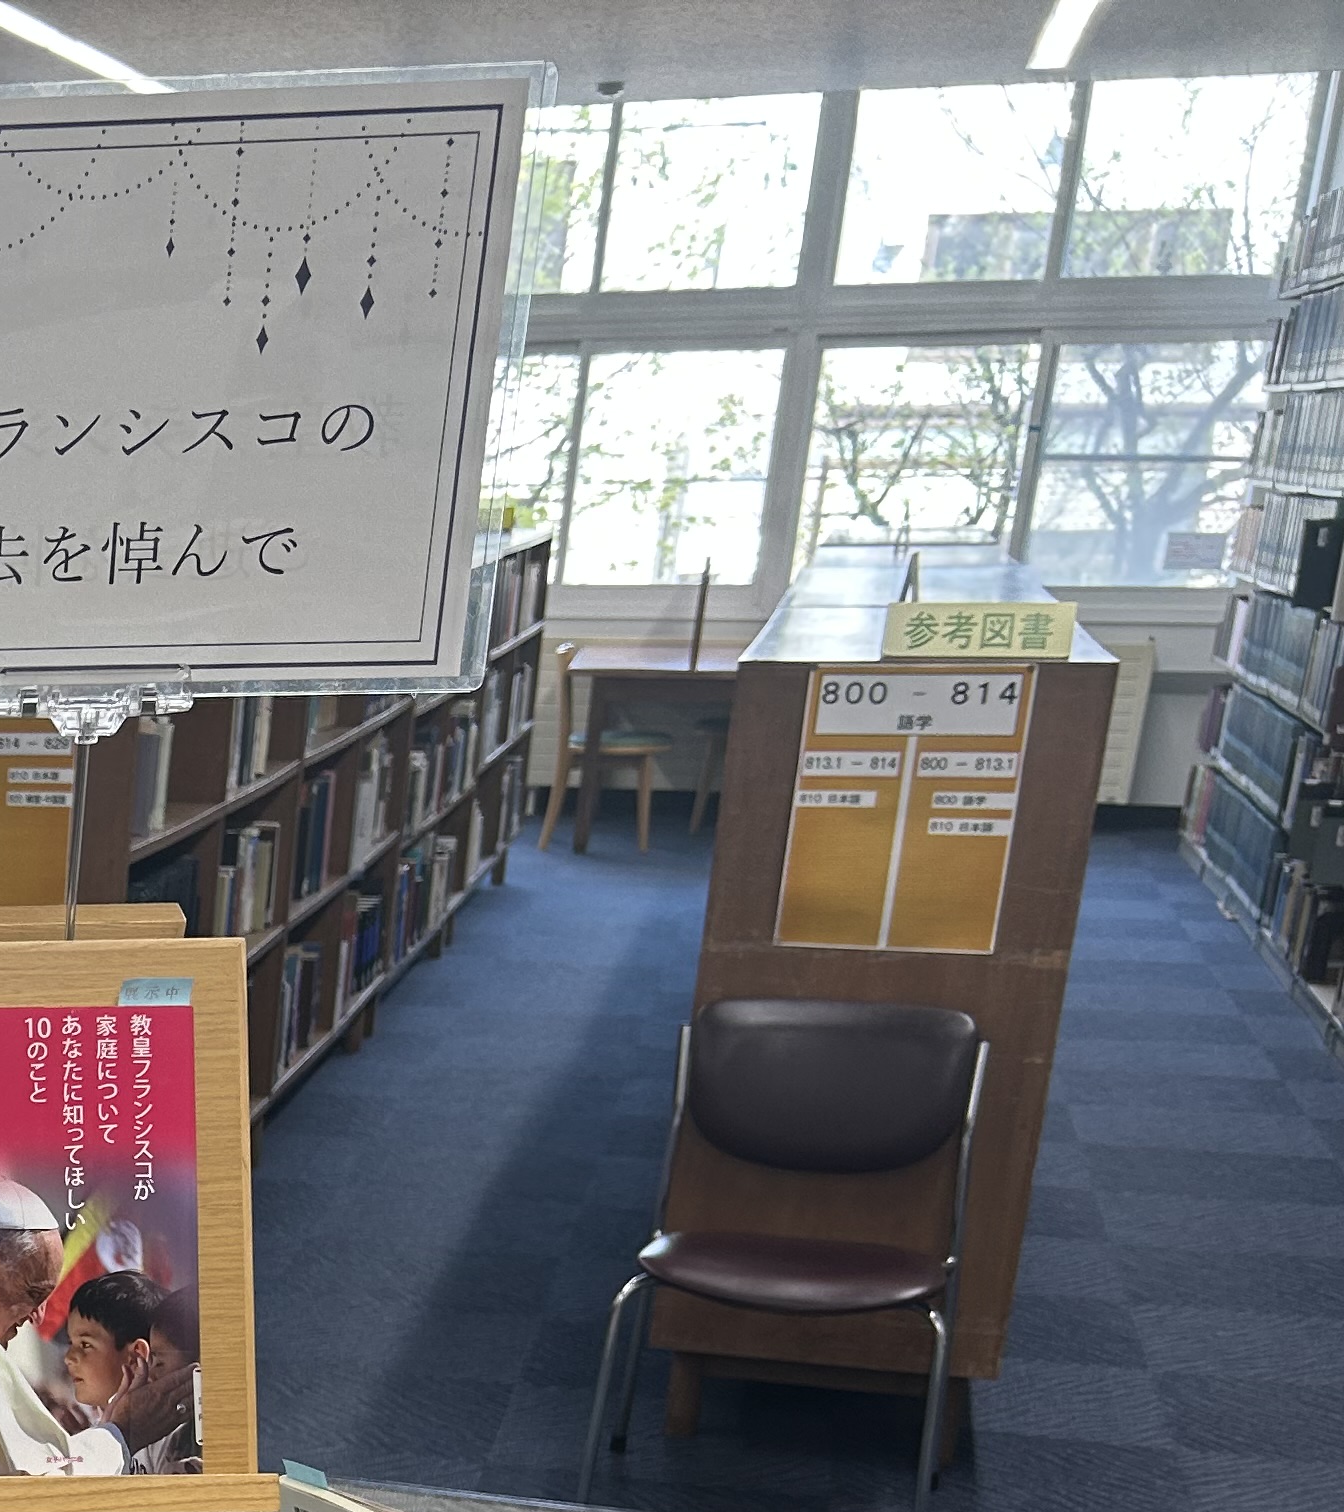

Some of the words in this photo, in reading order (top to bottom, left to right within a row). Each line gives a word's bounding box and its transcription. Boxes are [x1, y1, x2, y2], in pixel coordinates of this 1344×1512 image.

[905, 610, 1056, 650] 参考図書
[821, 681, 889, 705] 800
[951, 681, 1019, 706] 814
[920, 756, 948, 770] 800
[24, 1017, 52, 1104] 10のこと
[95, 1014, 118, 1144] 家庭について
[61, 1015, 86, 1231] あなたに知ってほしい
[130, 1014, 156, 1202] 教皇フランシスコが
